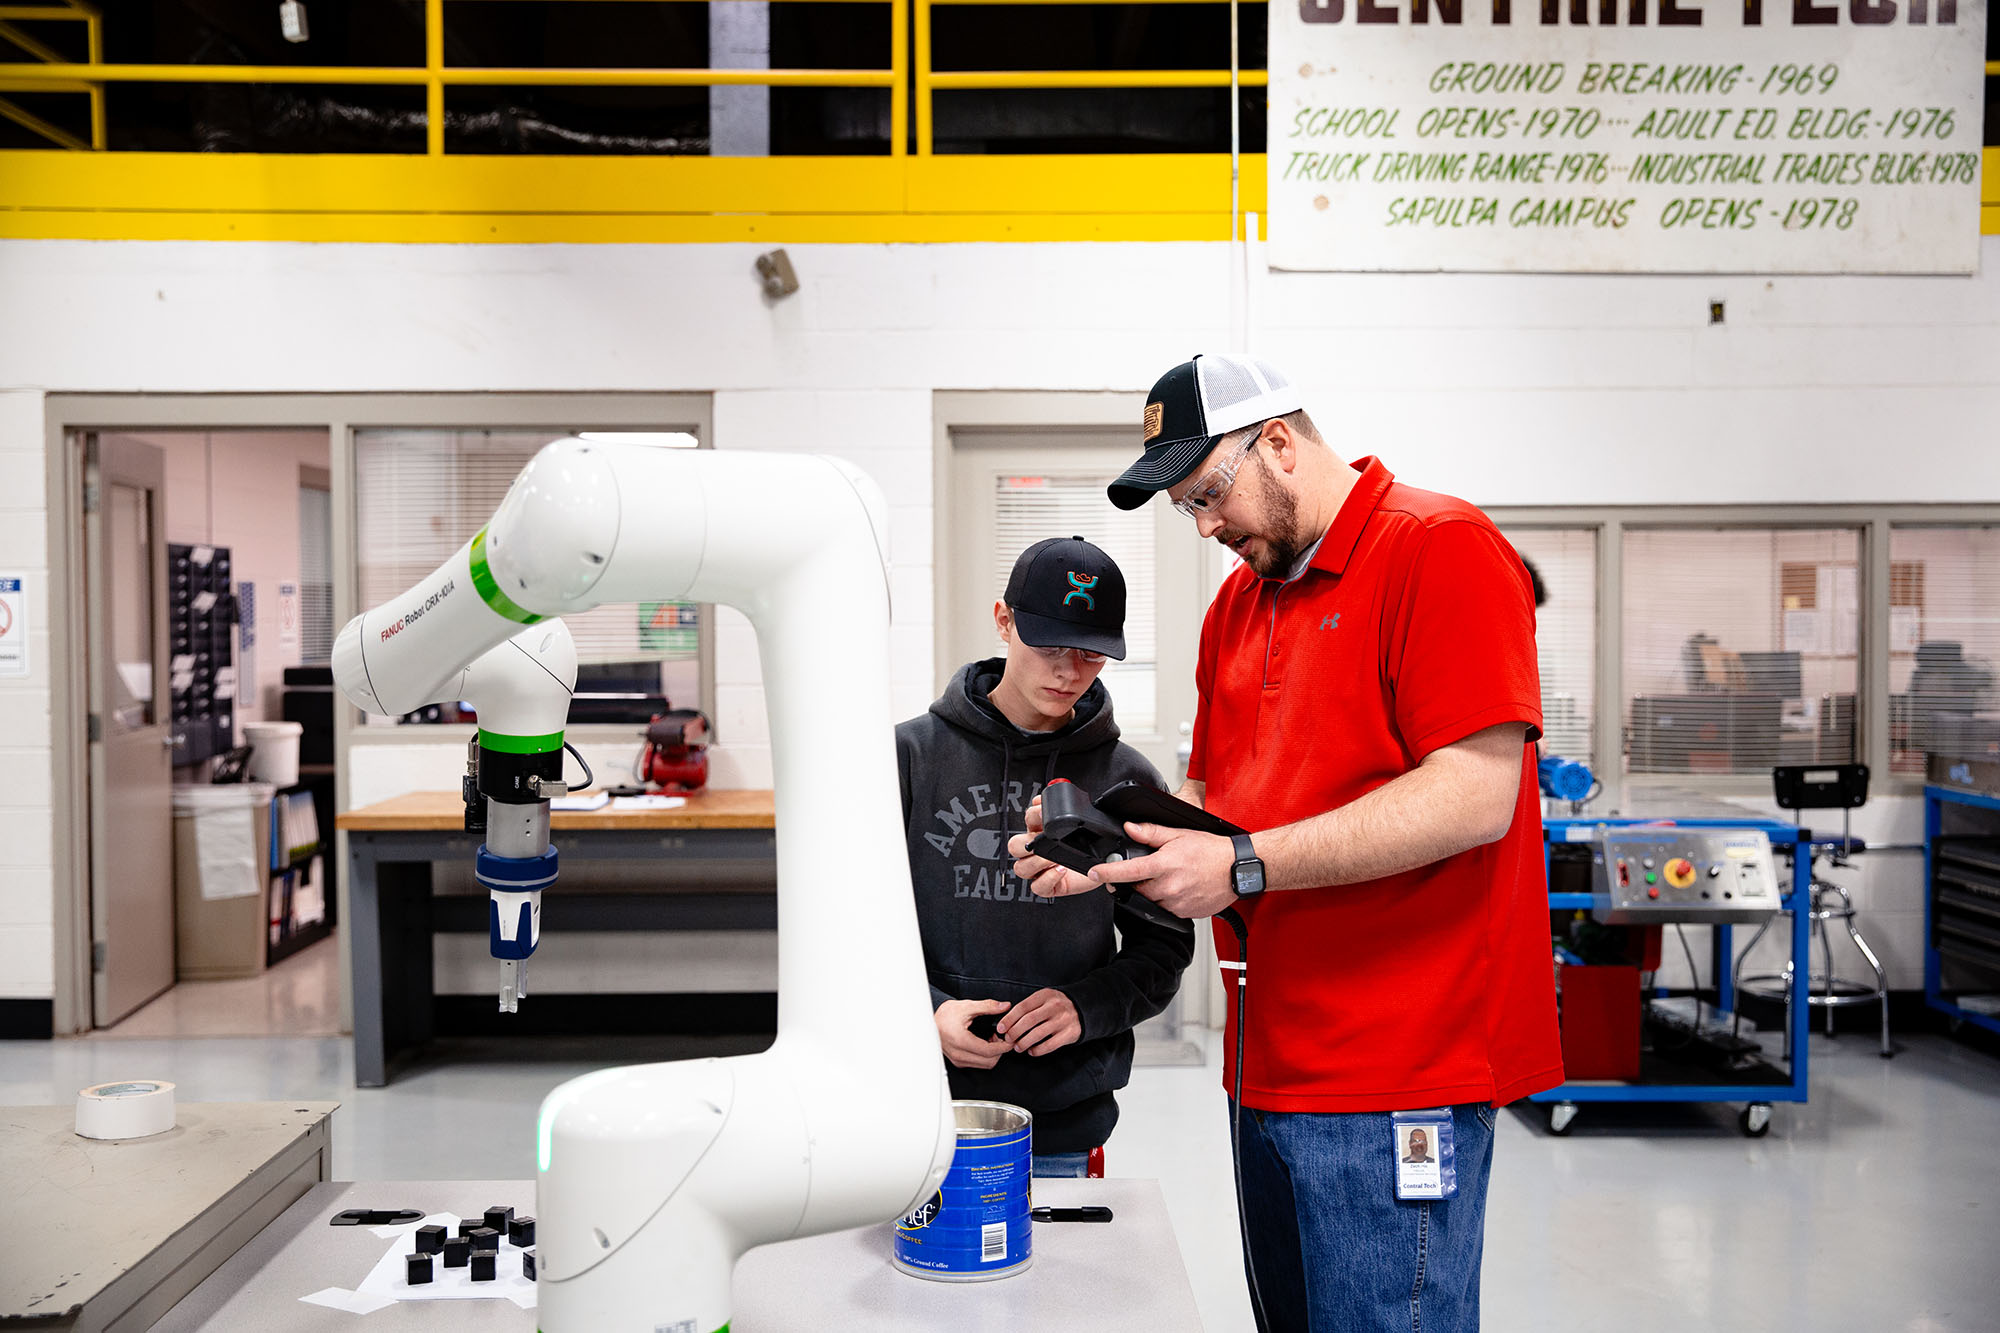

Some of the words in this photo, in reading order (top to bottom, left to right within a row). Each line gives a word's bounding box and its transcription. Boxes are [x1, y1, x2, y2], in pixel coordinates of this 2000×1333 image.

[1429, 62, 1566, 95] GROUND
[1288, 107, 1401, 139] SCHOOL
[1631, 107, 1733, 139] ADULT
[1283, 152, 1371, 182] TRUCK
[1373, 152, 1468, 183] DRIVING
[1627, 154, 1767, 184] INDUSTRIAL
[1772, 153, 1869, 184] TRADES
[1384, 197, 1500, 228] SAPULPA
[1508, 198, 1637, 228] CAMPUS
[1659, 199, 1764, 229] OPENS
[380, 618, 405, 643] FANUC
[404, 605, 425, 627] Robot
[953, 865, 1055, 904] EAGL
